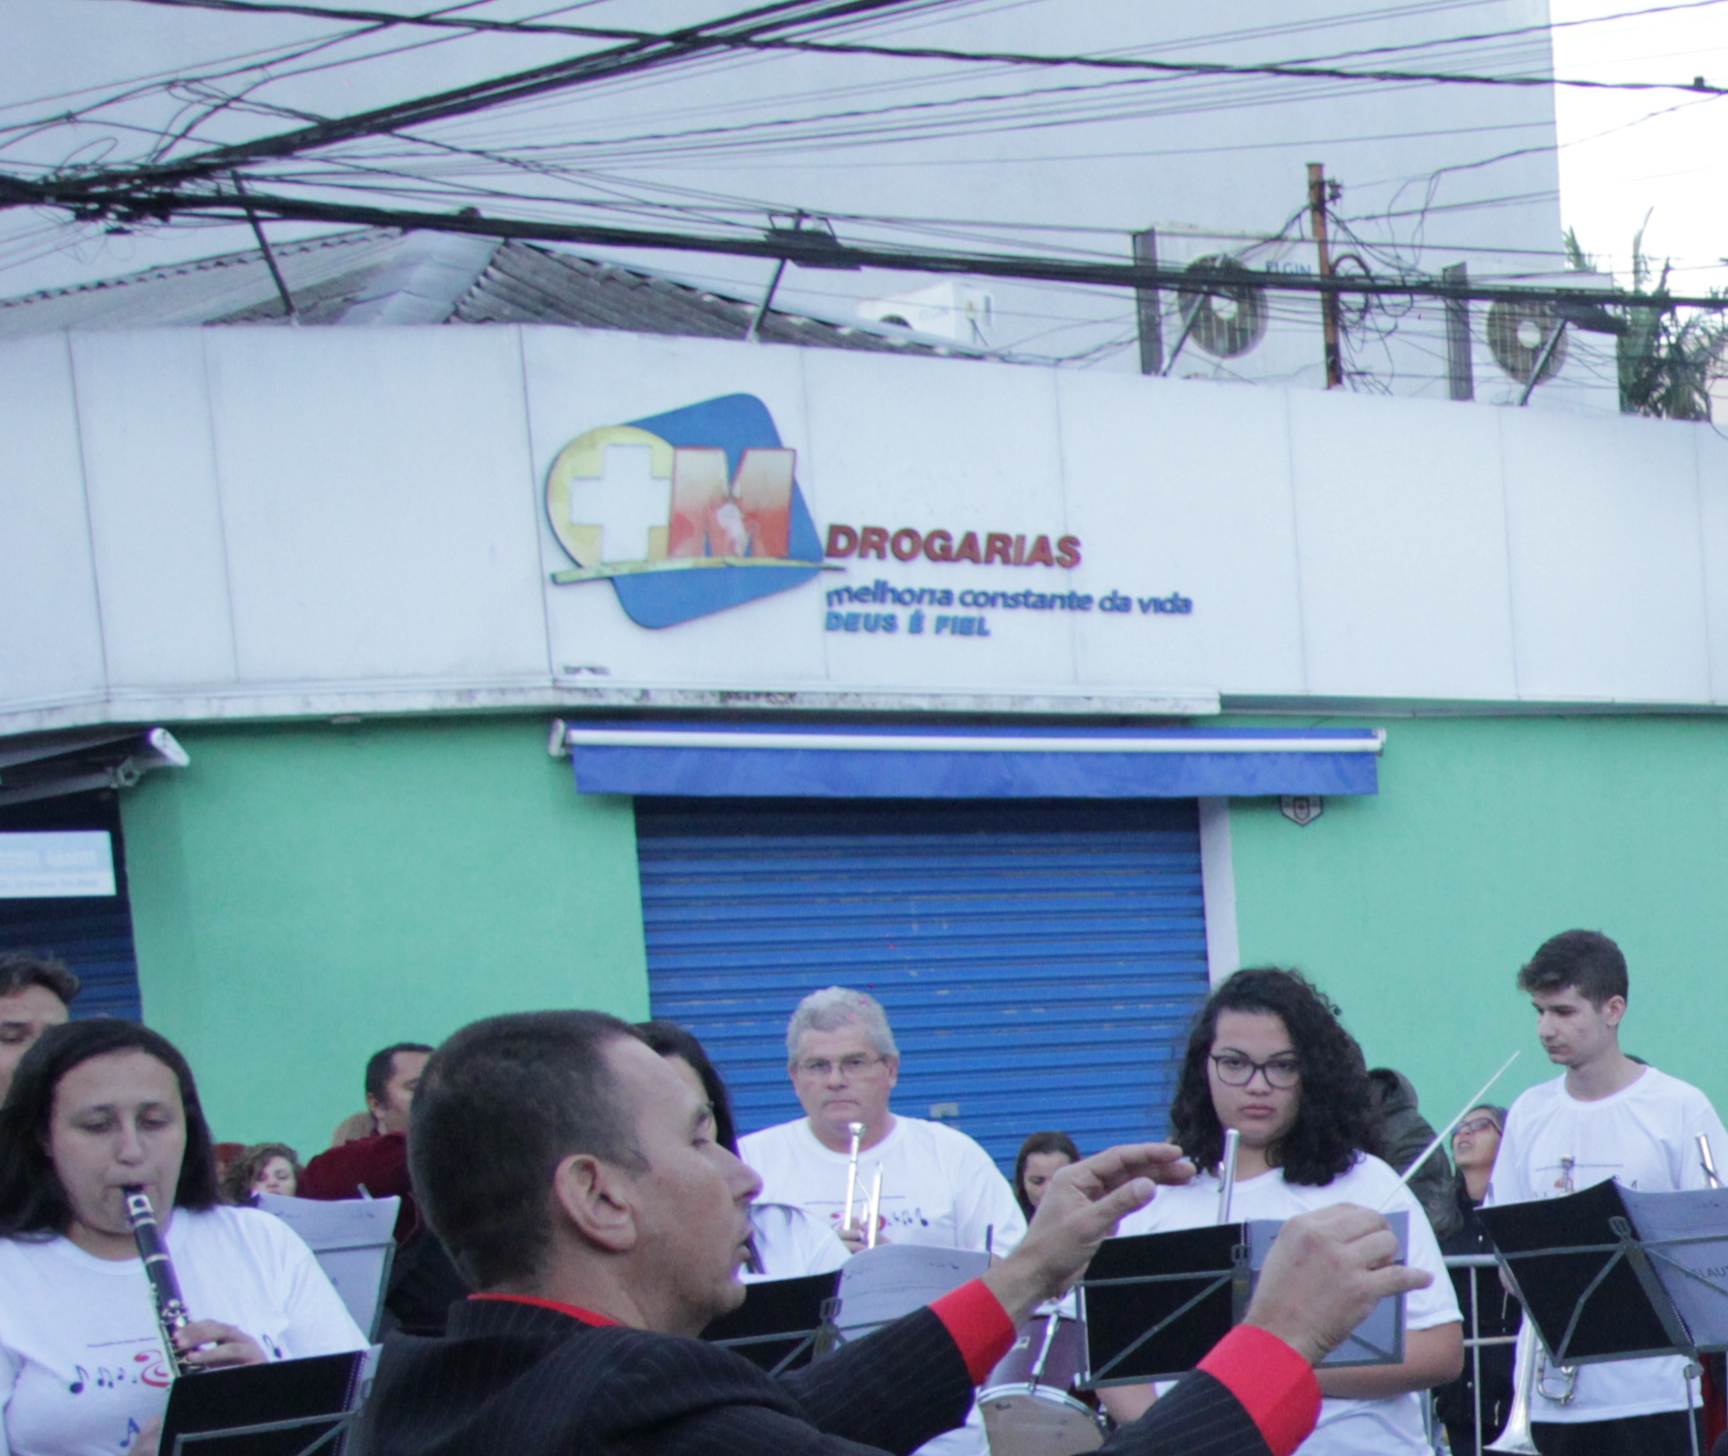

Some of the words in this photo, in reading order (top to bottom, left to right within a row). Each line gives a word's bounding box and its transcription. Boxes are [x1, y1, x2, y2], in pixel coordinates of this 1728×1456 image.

[825, 524, 1082, 569] DROGARIAS
[825, 578, 954, 608] melhoria
[958, 589, 1094, 612] constante
[1099, 590, 1132, 613] da
[1138, 592, 1193, 615] vida
[825, 611, 899, 632] DEUS
[908, 609, 925, 634] É
[935, 615, 991, 636] FIEL
